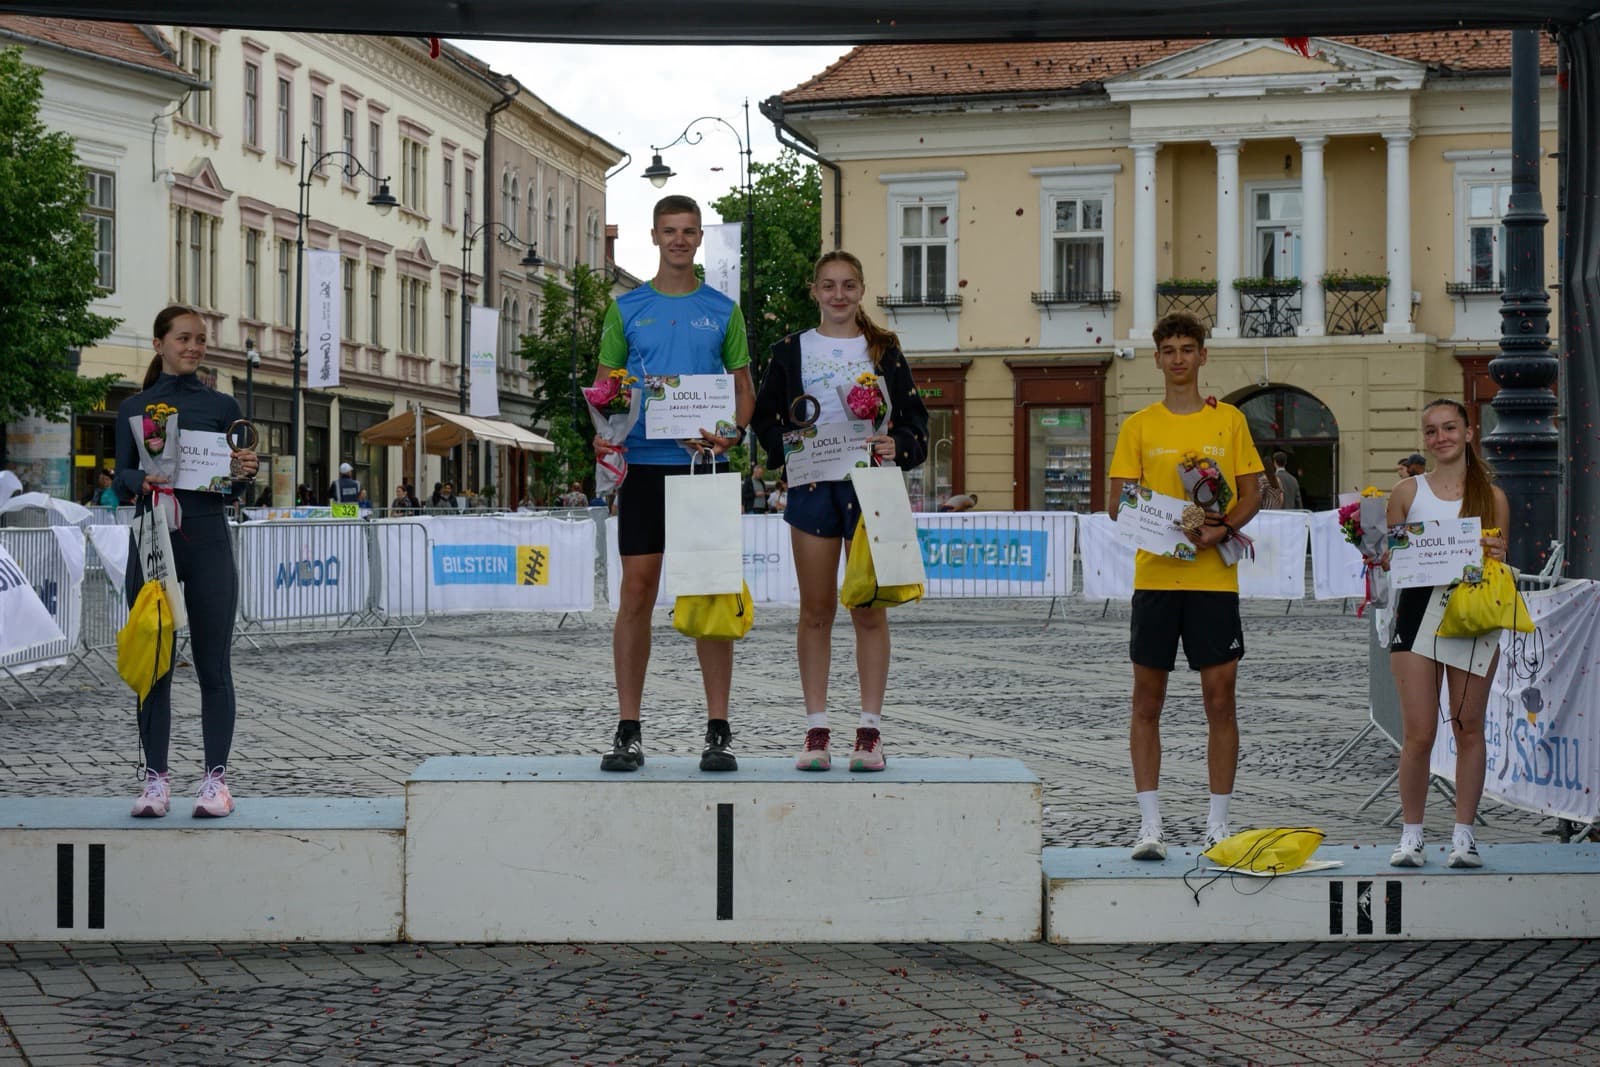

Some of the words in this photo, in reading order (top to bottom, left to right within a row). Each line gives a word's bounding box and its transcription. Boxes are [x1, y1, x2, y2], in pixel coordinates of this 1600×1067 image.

[673, 391, 702, 401] LOCUL
[812, 436, 841, 449] LOCUL
[180, 445, 201, 456] OCUL
[203, 447, 209, 456] II
[341, 505, 356, 517] 329
[1140, 503, 1165, 520] LOCUL
[1416, 538, 1446, 548] LOCUL
[1447, 536, 1456, 545] III
[442, 556, 508, 574] BILSTEIN
